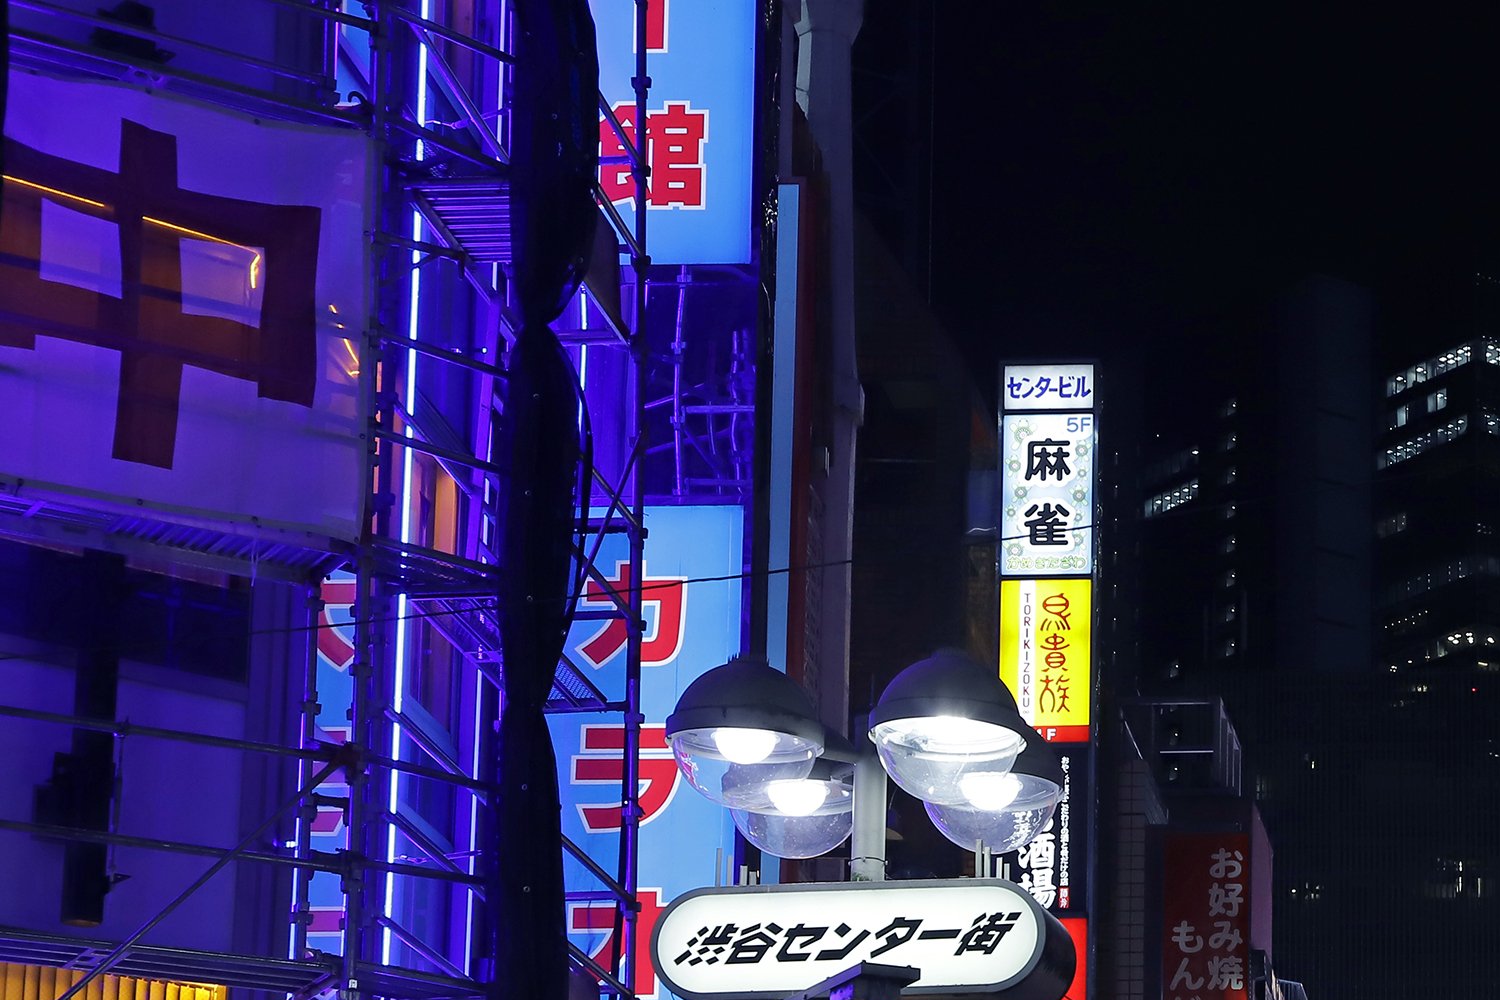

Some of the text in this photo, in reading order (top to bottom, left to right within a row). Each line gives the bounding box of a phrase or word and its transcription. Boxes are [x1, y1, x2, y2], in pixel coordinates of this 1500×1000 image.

[1007, 376, 1091, 399] センタービル
[1066, 417, 1091, 432] 5F
[1024, 438, 1071, 546] 麻雀
[1022, 594, 1031, 707] TORIKIZOKU
[675, 911, 1021, 967] 渋谷センター街
[1207, 848, 1243, 990] お好み焼
